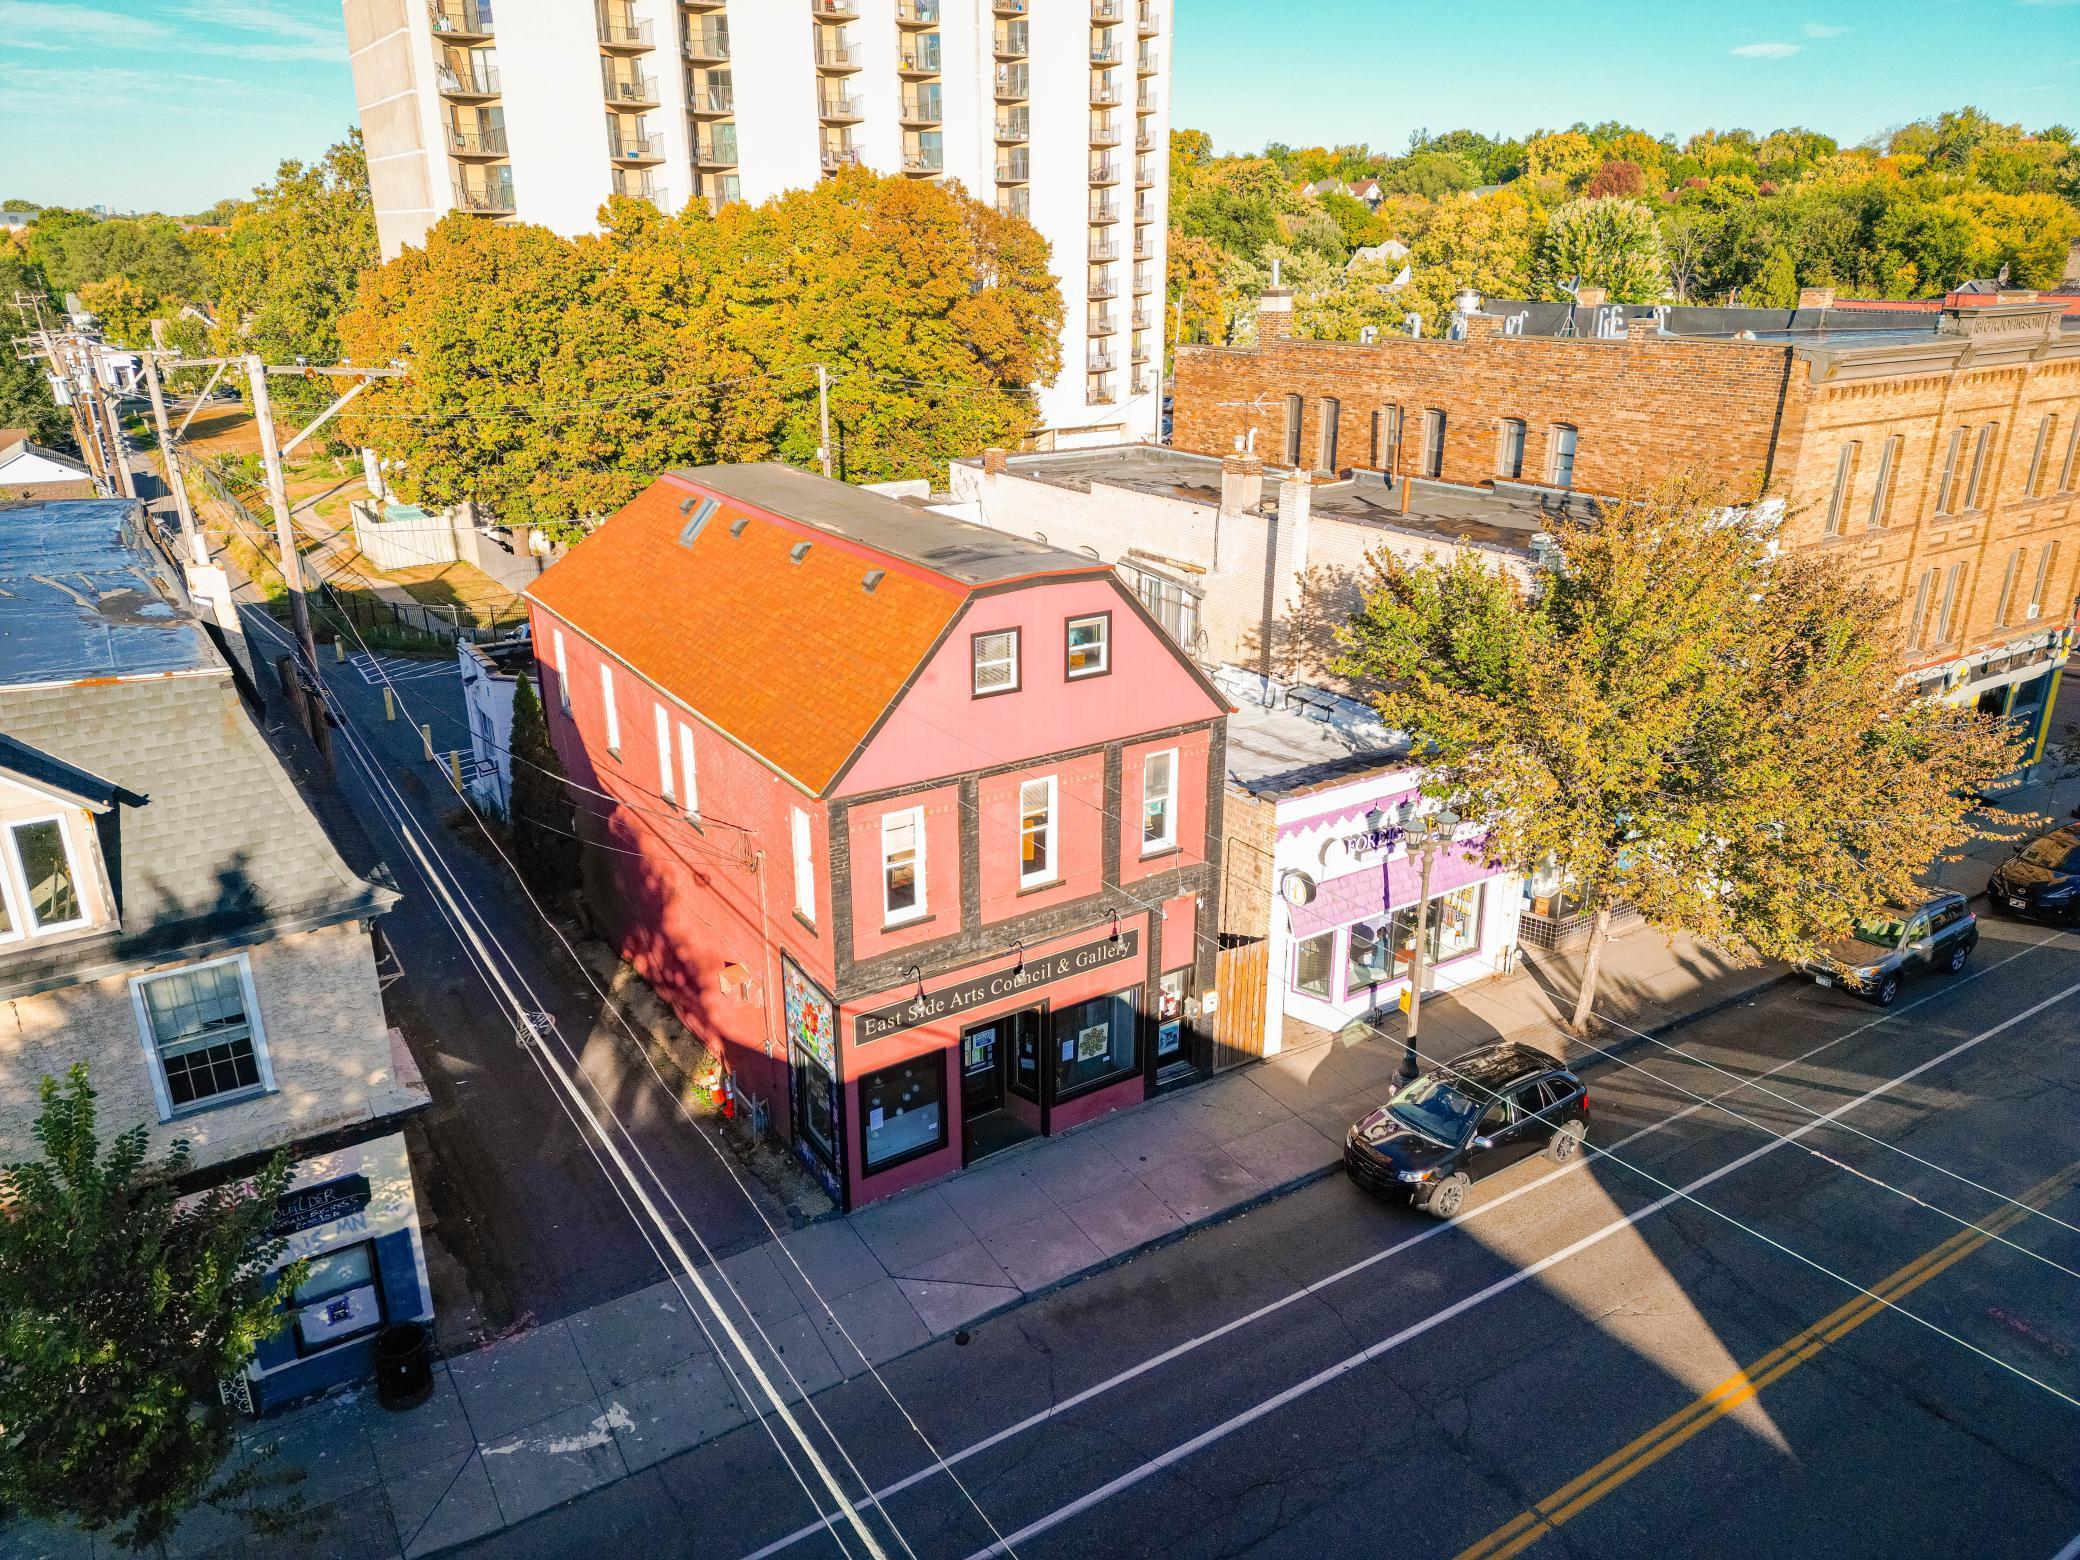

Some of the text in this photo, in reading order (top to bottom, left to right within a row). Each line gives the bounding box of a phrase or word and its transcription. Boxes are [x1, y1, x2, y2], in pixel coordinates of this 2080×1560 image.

[1347, 826, 1405, 853] FOREIG
[865, 1011, 902, 1036] East
[950, 988, 985, 1008] Arts
[991, 963, 1052, 995] Council
[1057, 958, 1071, 974] &
[1076, 942, 1131, 967] Gallery
